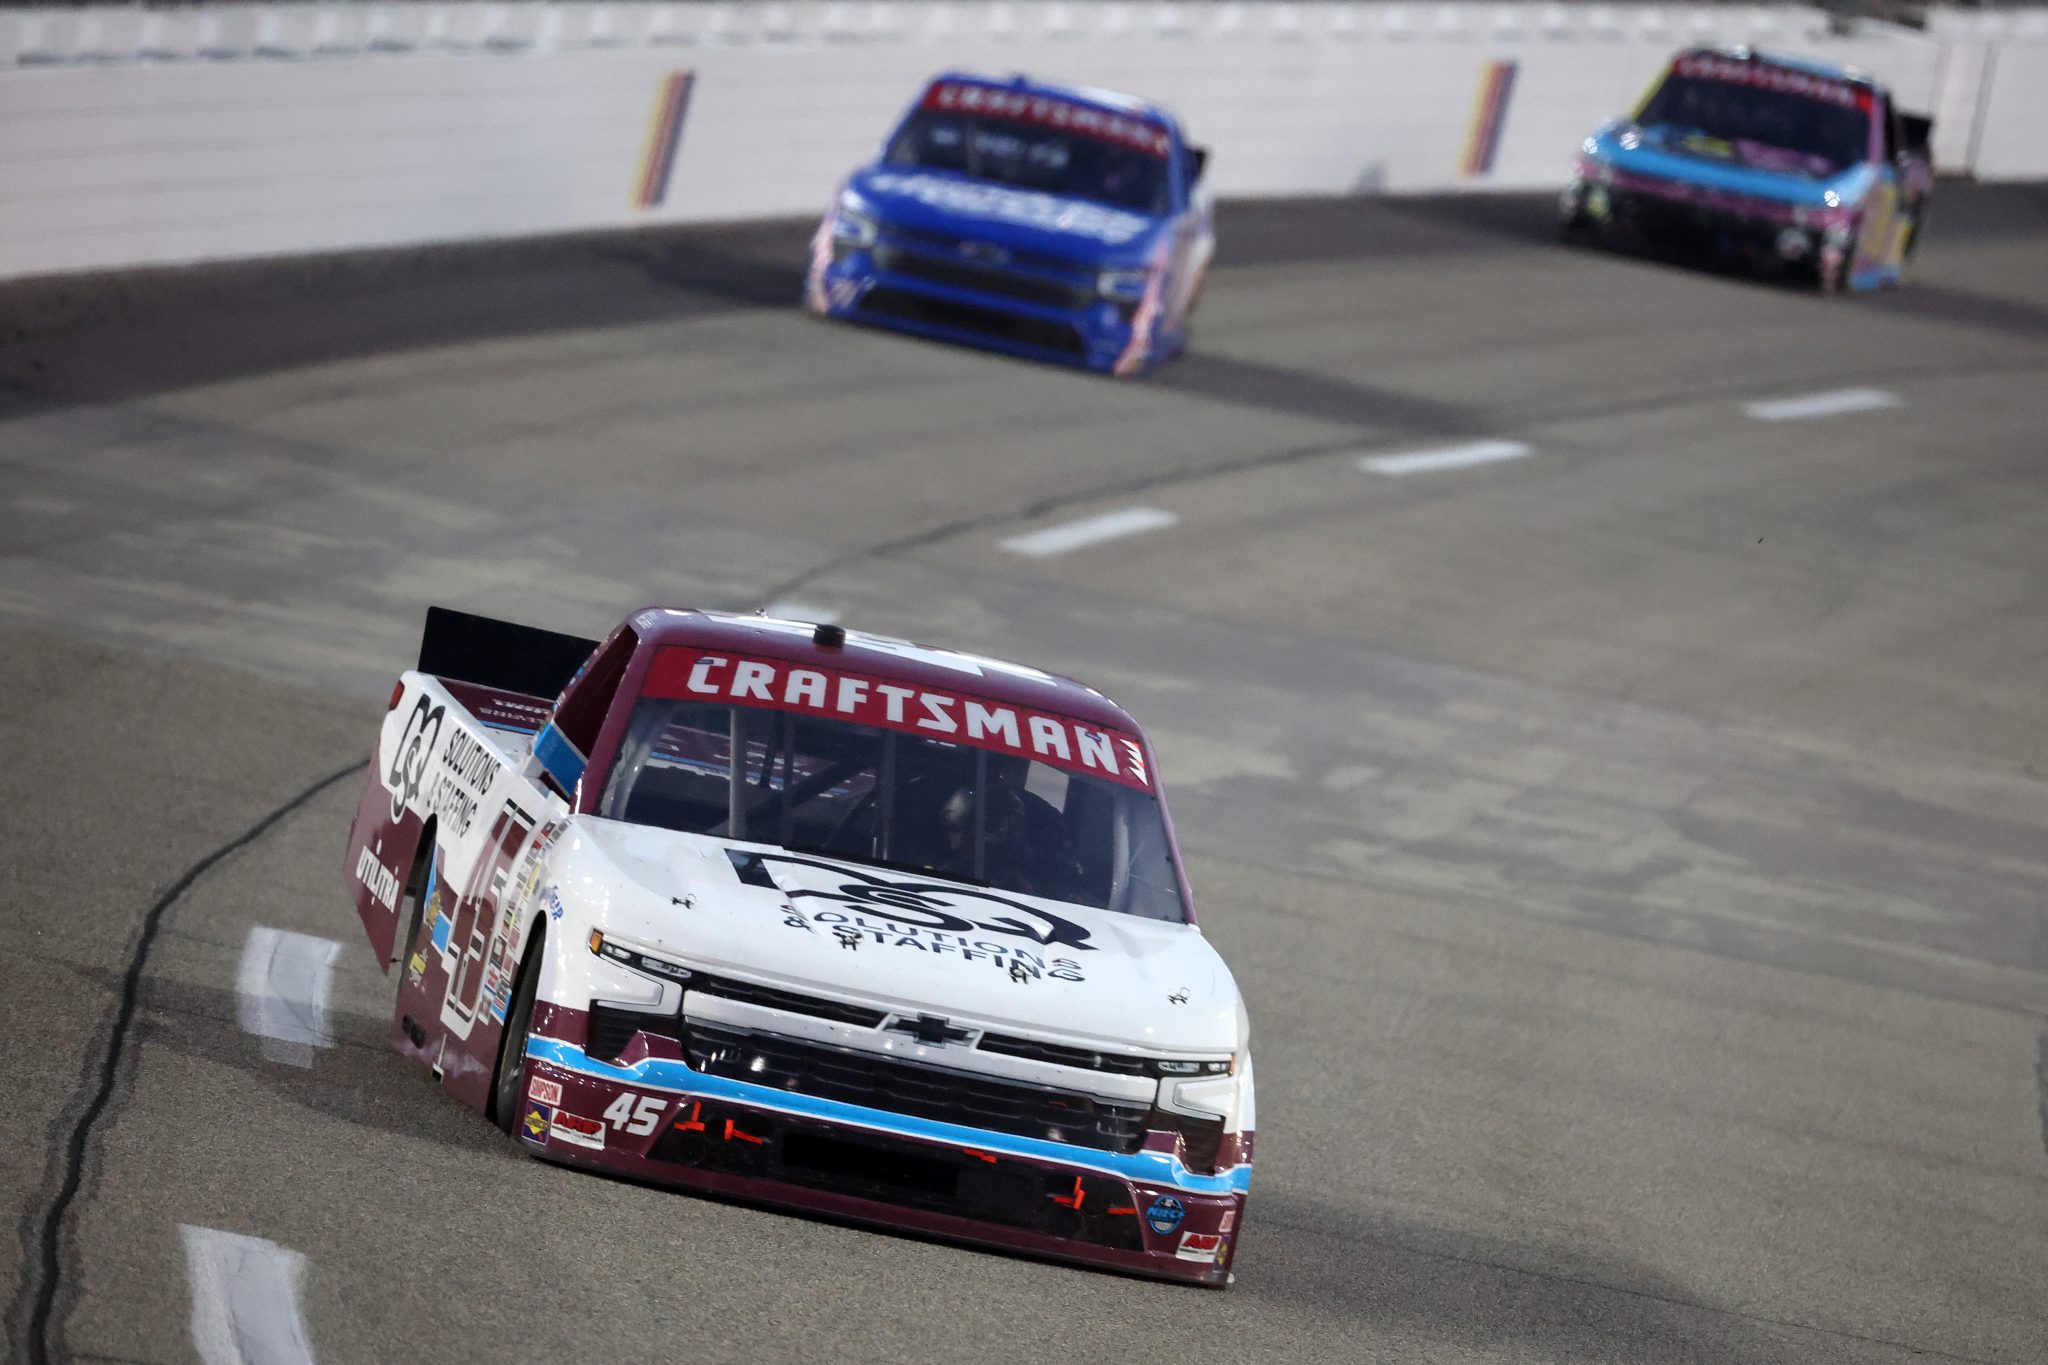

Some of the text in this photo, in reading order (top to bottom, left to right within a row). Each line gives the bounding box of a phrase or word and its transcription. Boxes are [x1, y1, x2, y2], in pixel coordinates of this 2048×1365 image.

[686, 656, 1121, 776] CRAFTSMAN
[442, 727, 502, 796] SOLUTIONS
[780, 904, 1082, 970] SOLUTIONS
[783, 915, 1086, 982] & STAFFING
[602, 1092, 669, 1137] 45
